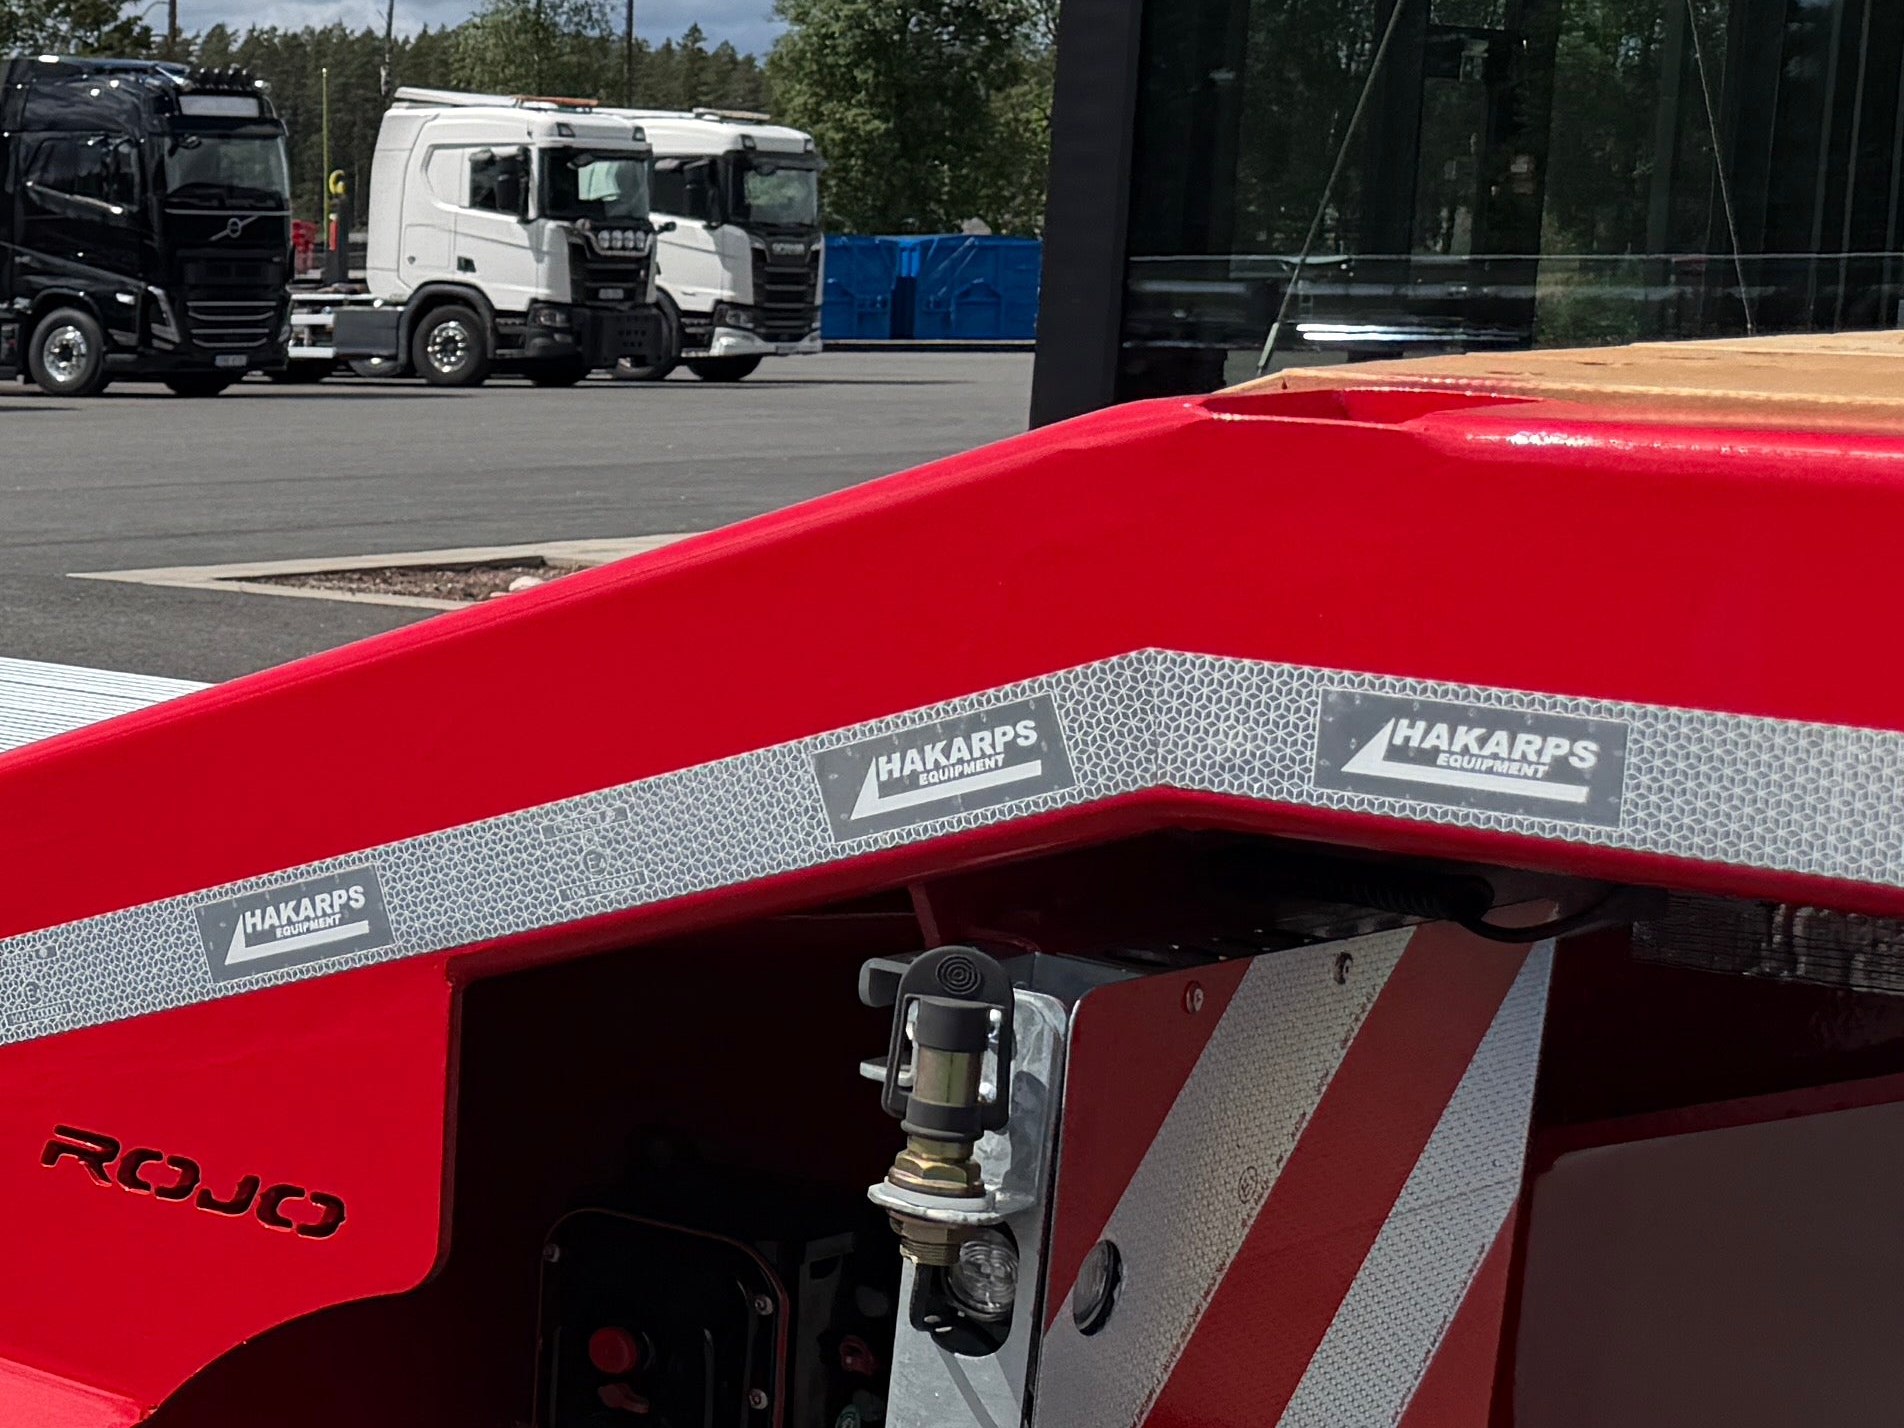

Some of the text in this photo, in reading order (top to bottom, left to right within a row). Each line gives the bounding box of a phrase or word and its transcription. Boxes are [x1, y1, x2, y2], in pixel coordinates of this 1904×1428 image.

[878, 720, 1038, 781] HAKARPS
[1392, 718, 1599, 769] HAKARPS
[1436, 753, 1549, 779] EQUIPMENT
[919, 754, 1005, 786] EQUIPMENT
[244, 885, 366, 934] HAKARPS
[275, 914, 341, 939] EQUIPMENT
[40, 1123, 346, 1239] ROJO
